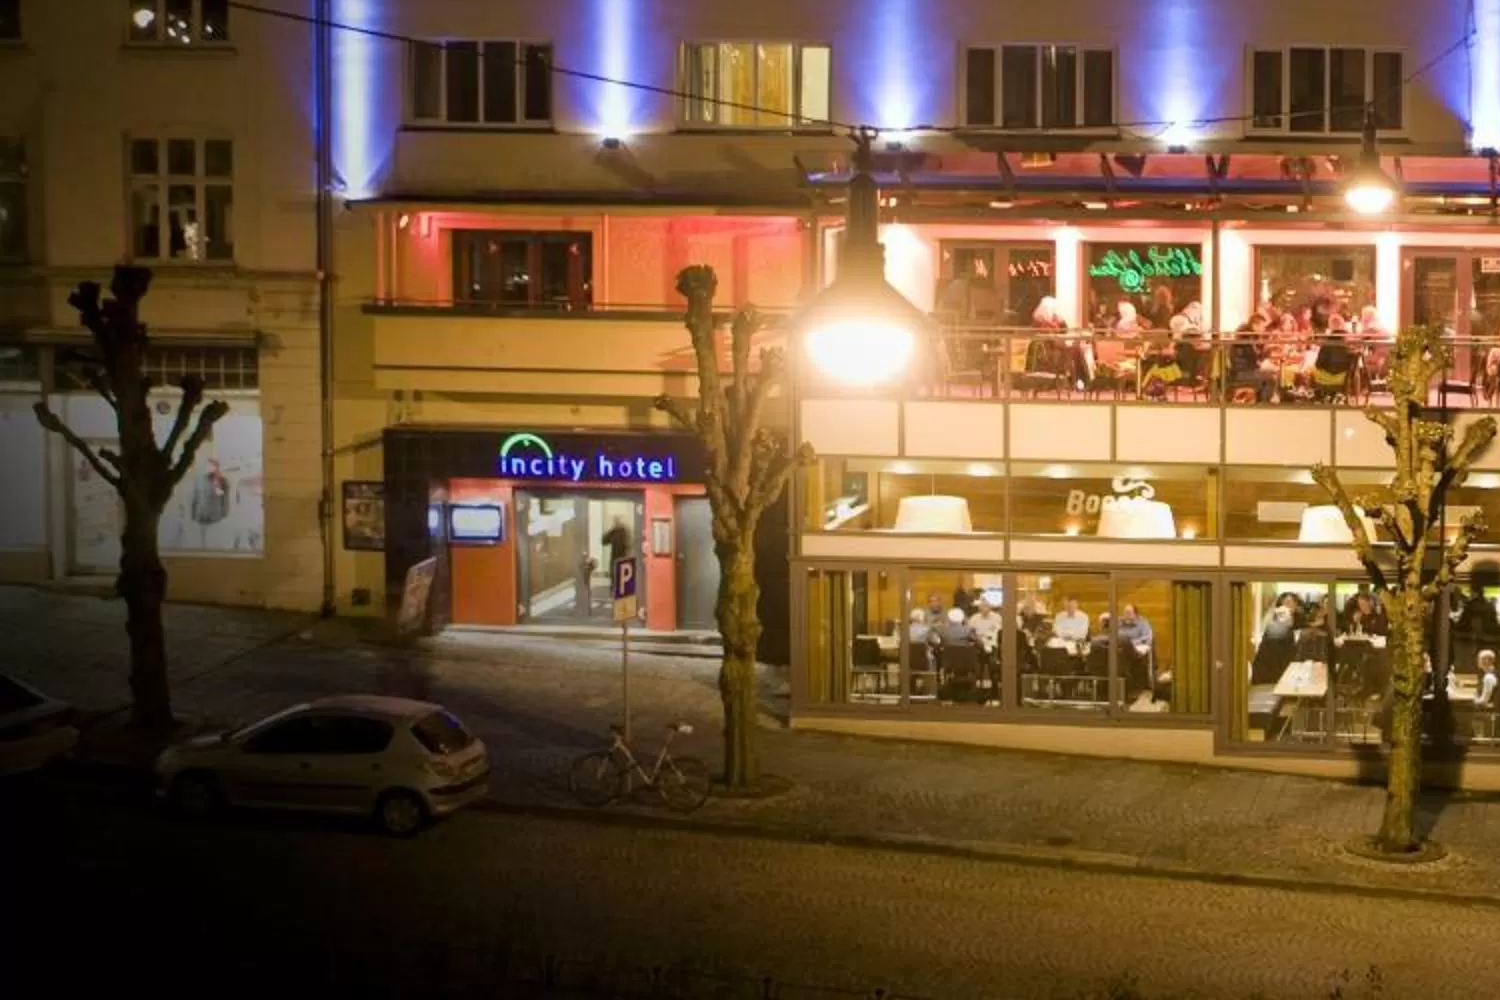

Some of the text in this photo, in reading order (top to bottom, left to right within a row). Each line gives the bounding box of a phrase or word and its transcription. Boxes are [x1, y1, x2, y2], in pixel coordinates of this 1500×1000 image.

[501, 455, 674, 481] incity hotel
[619, 562, 633, 596] P
